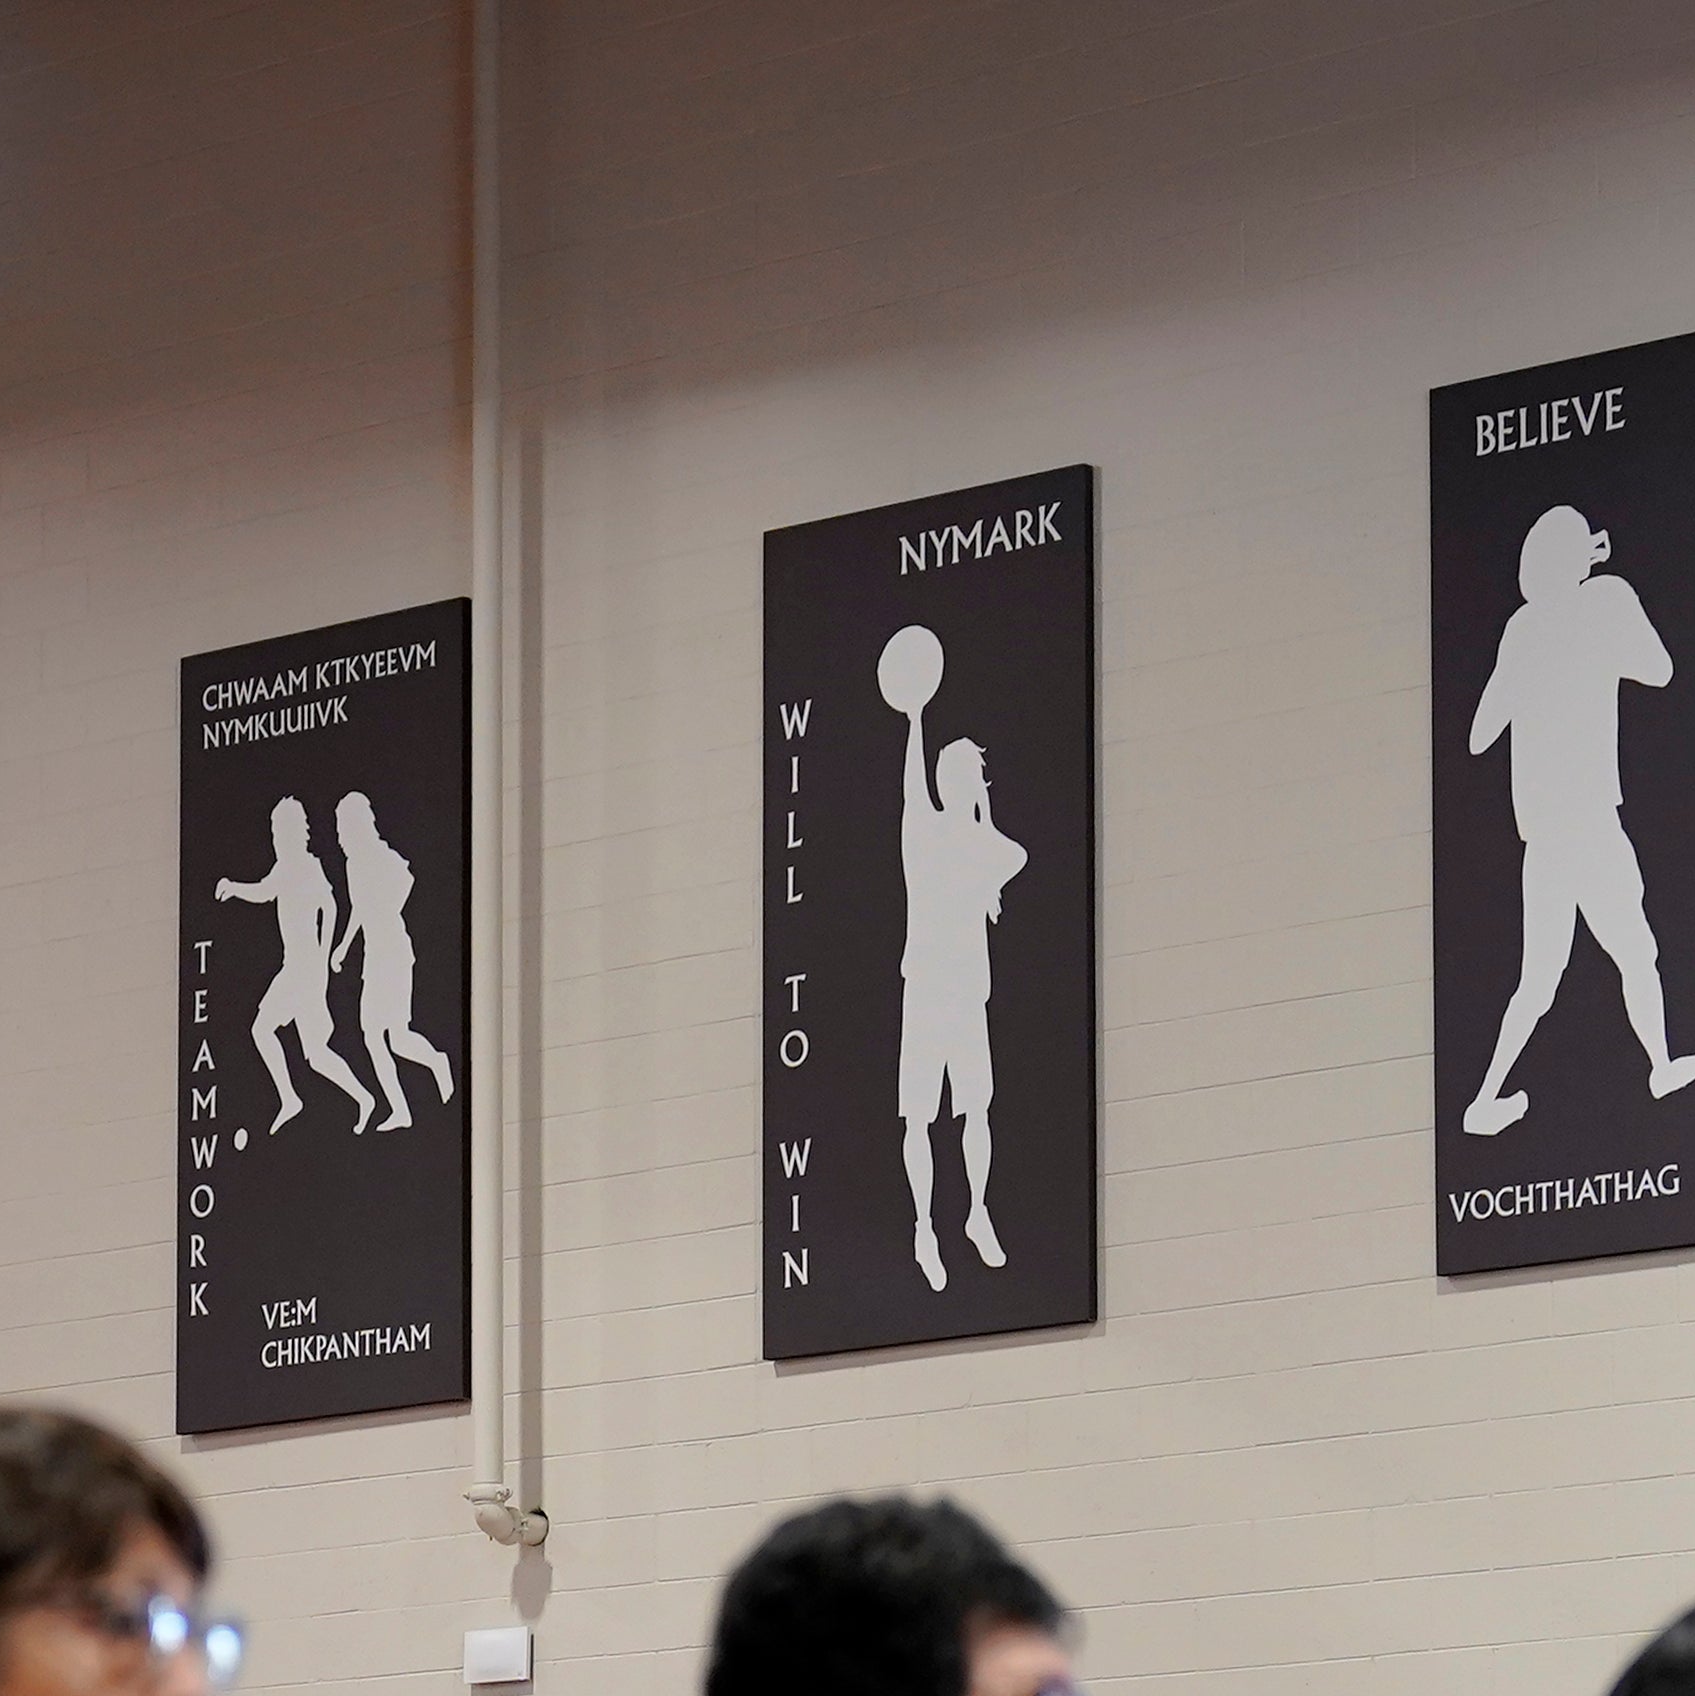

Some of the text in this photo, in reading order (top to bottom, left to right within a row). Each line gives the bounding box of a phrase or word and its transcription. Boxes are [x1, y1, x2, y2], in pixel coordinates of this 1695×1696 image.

[1475, 386, 1627, 458] BELIEVE
[897, 500, 1063, 577] NYMARK
[201, 639, 437, 713] CHWAAM KTKYEEVM
[201, 694, 350, 751] NYMKUUIIVK
[778, 697, 813, 1290] WILL TO WIN
[189, 939, 219, 1318] TEAMWORK
[1447, 1163, 1681, 1224] VOCHTHATHAG
[260, 1321, 432, 1369] CHIKPANTHAM
